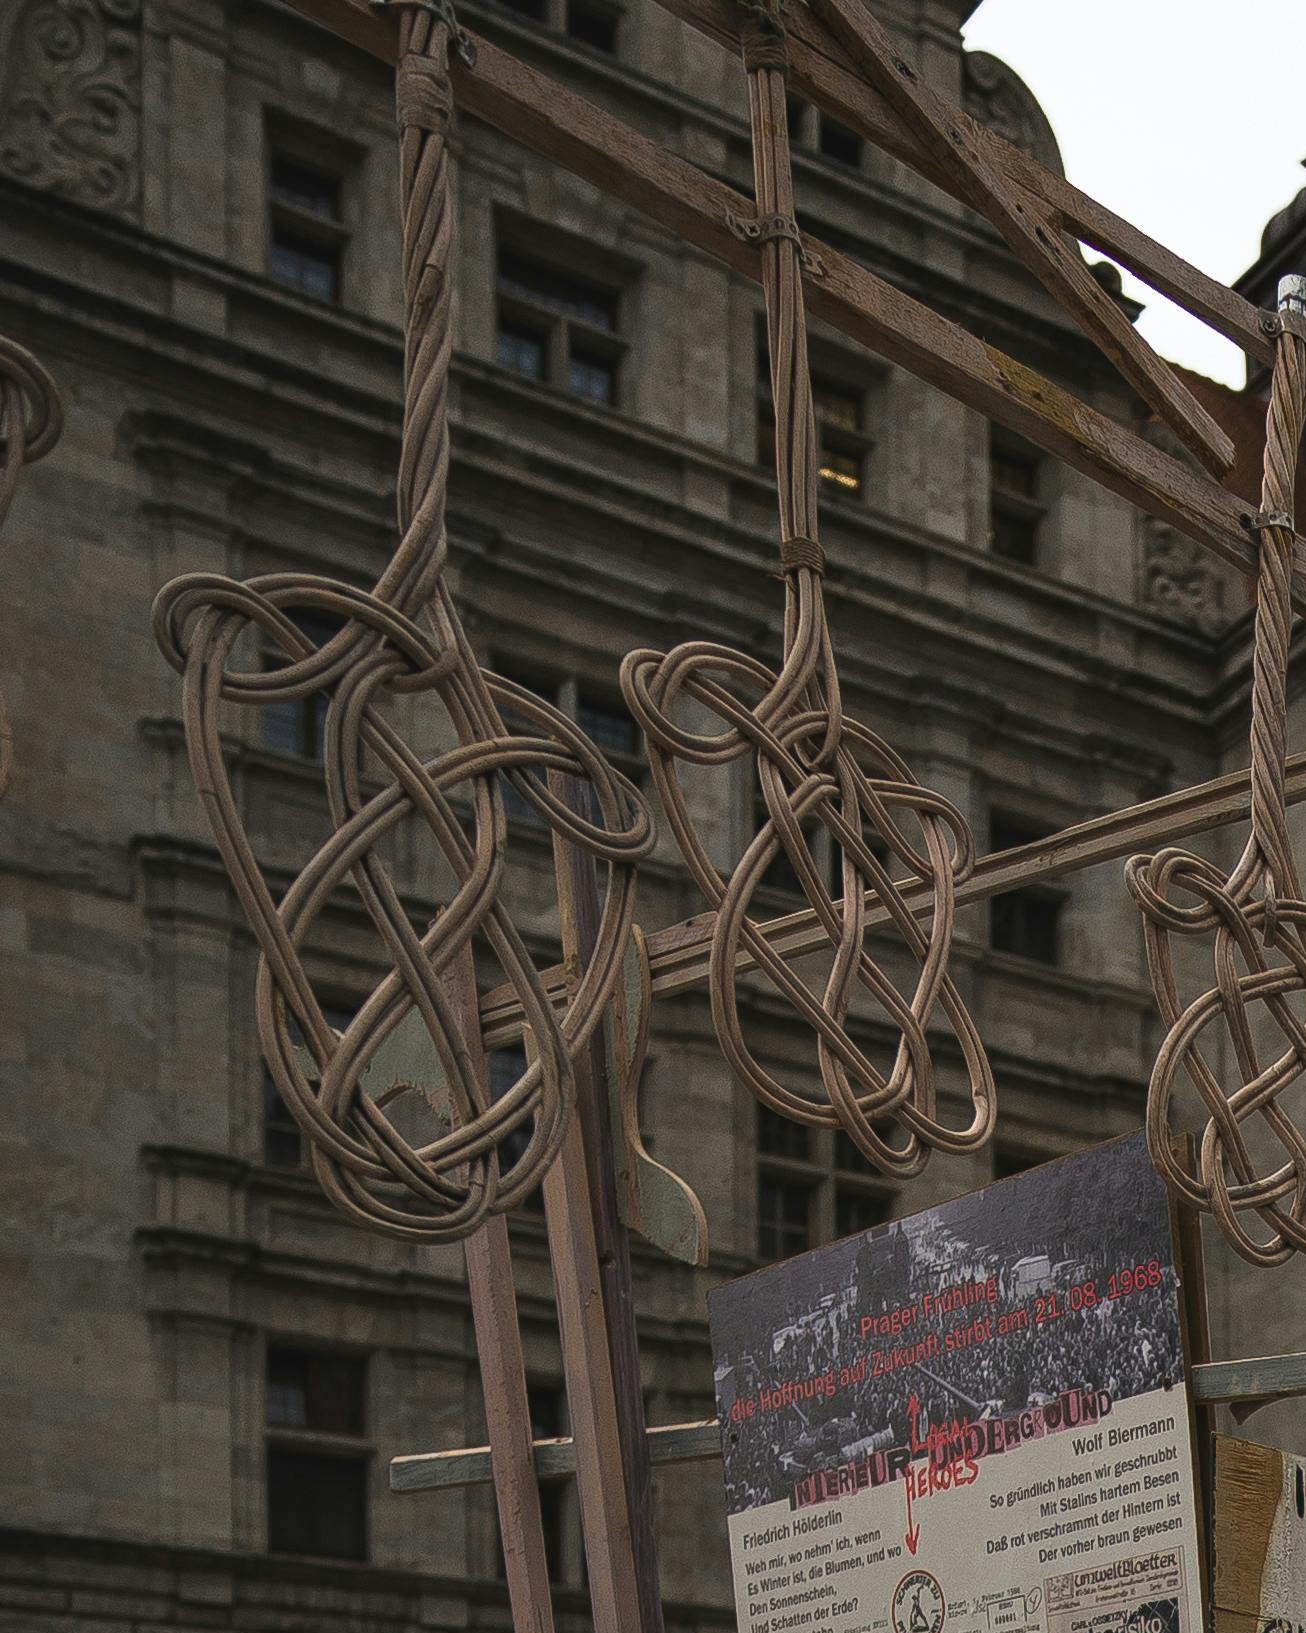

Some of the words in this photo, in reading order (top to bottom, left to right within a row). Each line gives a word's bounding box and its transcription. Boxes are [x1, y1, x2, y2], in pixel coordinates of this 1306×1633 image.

[860, 1303, 918, 1341] Prager
[923, 1274, 998, 1320] Frühling
[730, 1396, 756, 1423] die
[760, 1369, 836, 1413] Hoffnung
[840, 1358, 868, 1387] auf
[872, 1334, 939, 1378] Zukunft
[945, 1319, 992, 1353] stirbt
[997, 1307, 1029, 1337] am
[1033, 1294, 1065, 1325] 21.
[1108, 1259, 1162, 1300] 1968
[1072, 1433, 1103, 1456] Wolf
[1108, 1416, 1175, 1448] Biermann
[989, 1493, 1004, 1509] So
[1006, 1478, 1056, 1507] gründlich
[1057, 1469, 1092, 1490] haben
[1095, 1463, 1111, 1481] wir
[1114, 1445, 1178, 1478] geschrubbt
[1039, 1498, 1058, 1518] Mit
[1060, 1491, 1098, 1513] Stalins
[1100, 1480, 1141, 1502] hartem
[1144, 1470, 1180, 1490] Besen
[743, 1525, 790, 1550] Friedrich
[793, 1510, 843, 1536] Hölderlin
[986, 1536, 1008, 1554] Daß
[1010, 1532, 1026, 1548] rot
[1027, 1513, 1100, 1544] verschrammt
[1101, 1508, 1120, 1526] der
[1122, 1497, 1164, 1520] Hintern
[1167, 1491, 1181, 1509] ist
[1039, 1546, 1057, 1563] Der
[1060, 1537, 1095, 1557] vorher
[1098, 1529, 1130, 1548] braun
[1132, 1516, 1183, 1543] gewesen
[745, 1560, 767, 1576] Weh
[768, 1554, 787, 1570] mir,
[789, 1552, 803, 1565] wo
[854, 1529, 881, 1546] wenn
[747, 1581, 759, 1596] Es
[760, 1574, 791, 1593] Winter
[793, 1570, 807, 1585] ist,
[809, 1565, 823, 1580] die
[825, 1555, 865, 1576] Blumen,
[867, 1549, 885, 1565] und
[888, 1545, 902, 1558] wo
[749, 1601, 768, 1617] Den
[770, 1584, 837, 1608] Sonnenschein,
[771, 1611, 812, 1633] Schatten
[814, 1606, 830, 1621] der
[832, 1597, 859, 1617] Erde?
